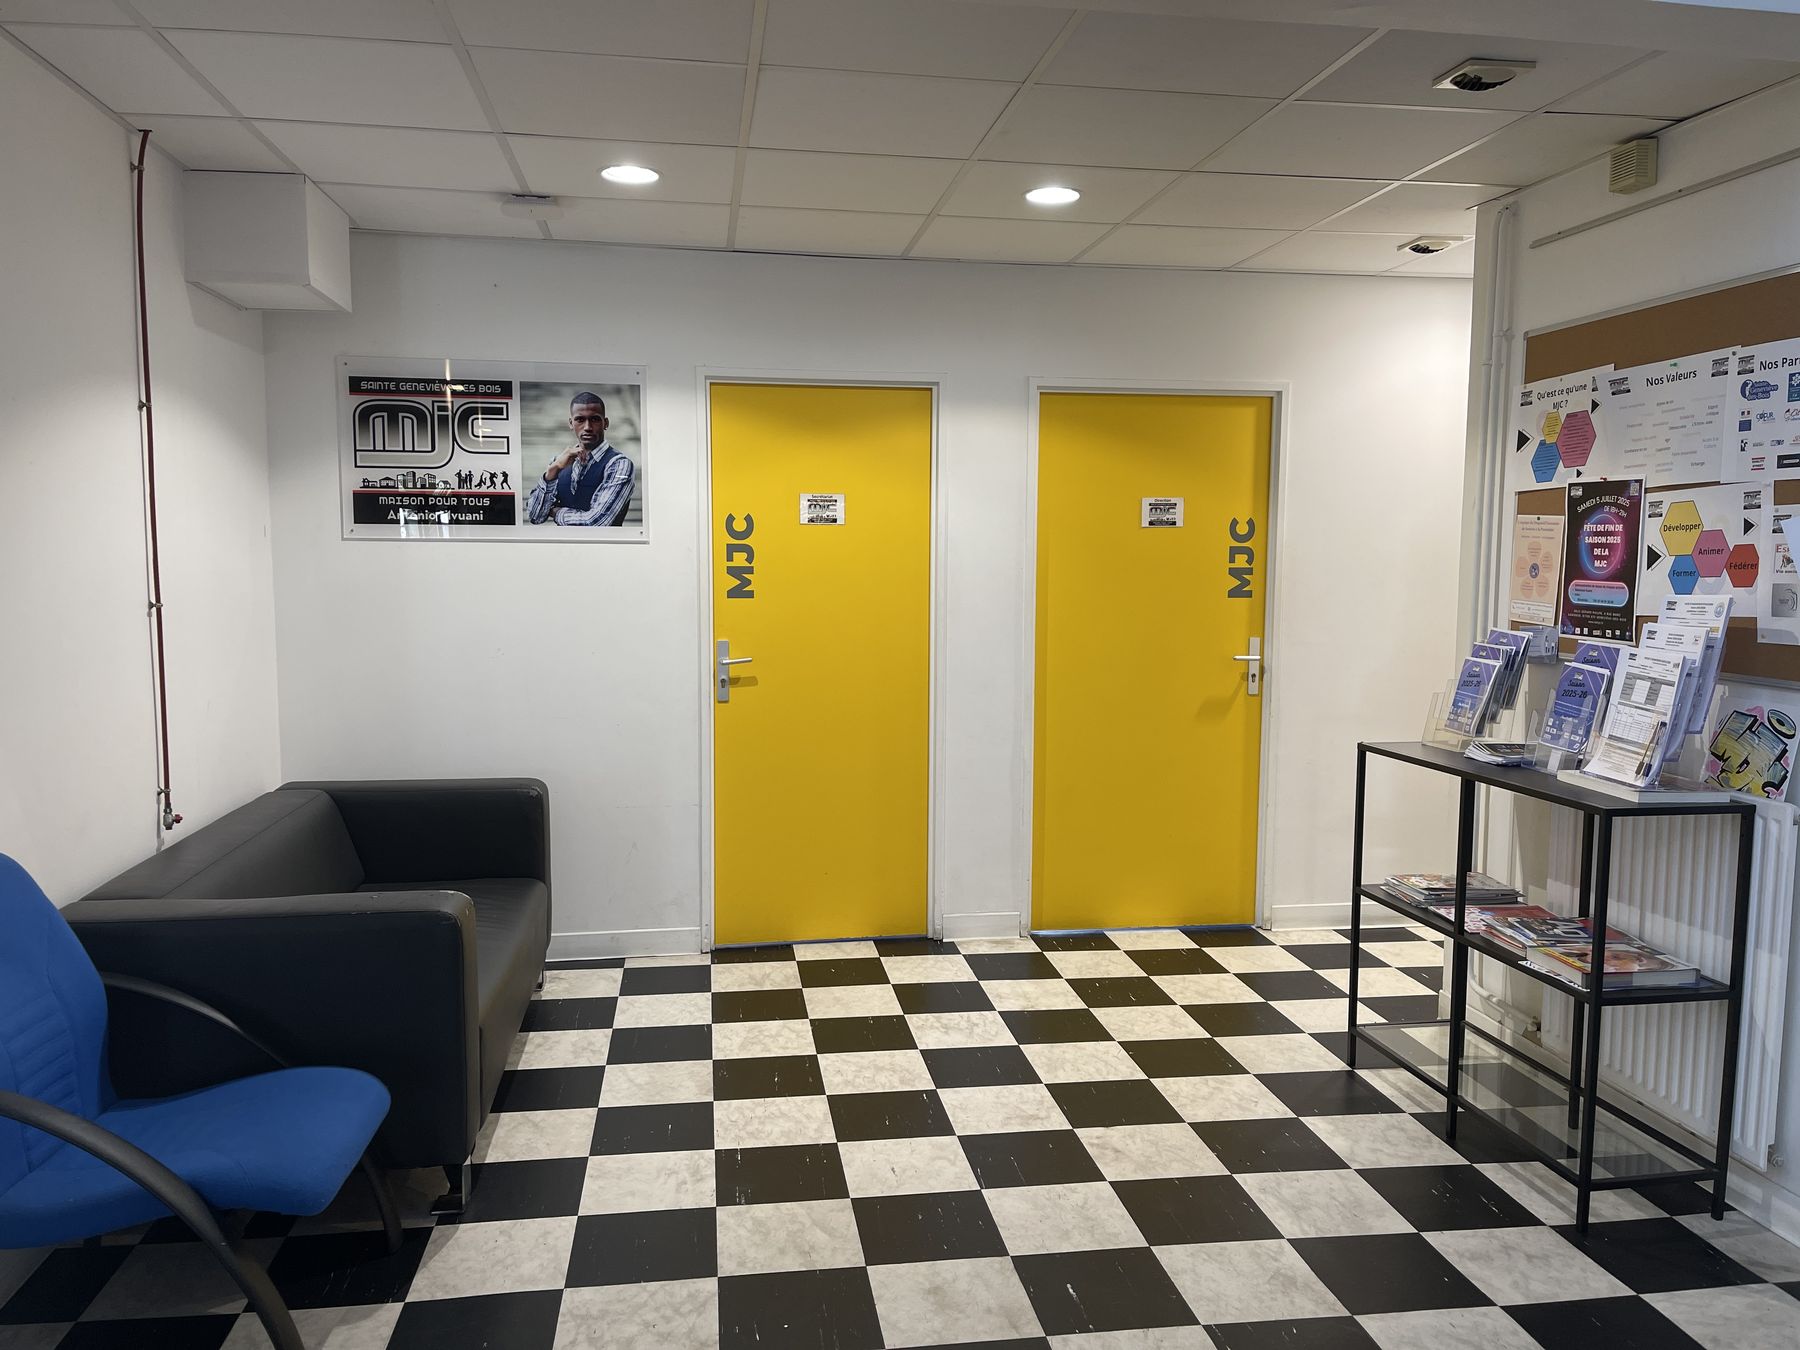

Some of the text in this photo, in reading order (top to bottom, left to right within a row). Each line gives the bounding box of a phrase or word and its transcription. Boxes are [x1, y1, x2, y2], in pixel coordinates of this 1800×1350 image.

[1760, 357, 1800, 371] Nos Par
[1646, 370, 1697, 387] Nos Valeurs
[360, 381, 397, 391] SAINTE
[456, 383, 476, 393] ES
[479, 384, 501, 393] BOIS
[379, 496, 490, 506] MAISON POUR TOUS
[1577, 495, 1631, 513] SAMEDI 5 JUILLET 2025
[387, 509, 436, 520] Anio
[1583, 522, 1623, 532] FÊTE DE FIN DE
[1663, 523, 1701, 533] Développer
[1584, 536, 1621, 544] SAISON 2025
[725, 512, 755, 599] MJC
[1593, 548, 1609, 556] DE LA
[1698, 547, 1724, 556] Animer
[1227, 517, 1255, 598] MJC
[1594, 560, 1608, 568] MJC
[1729, 561, 1758, 570] Fédérer
[1672, 569, 1697, 577] Former
[1568, 679, 1586, 688] Saison
[1561, 689, 1588, 699] 2025-26
